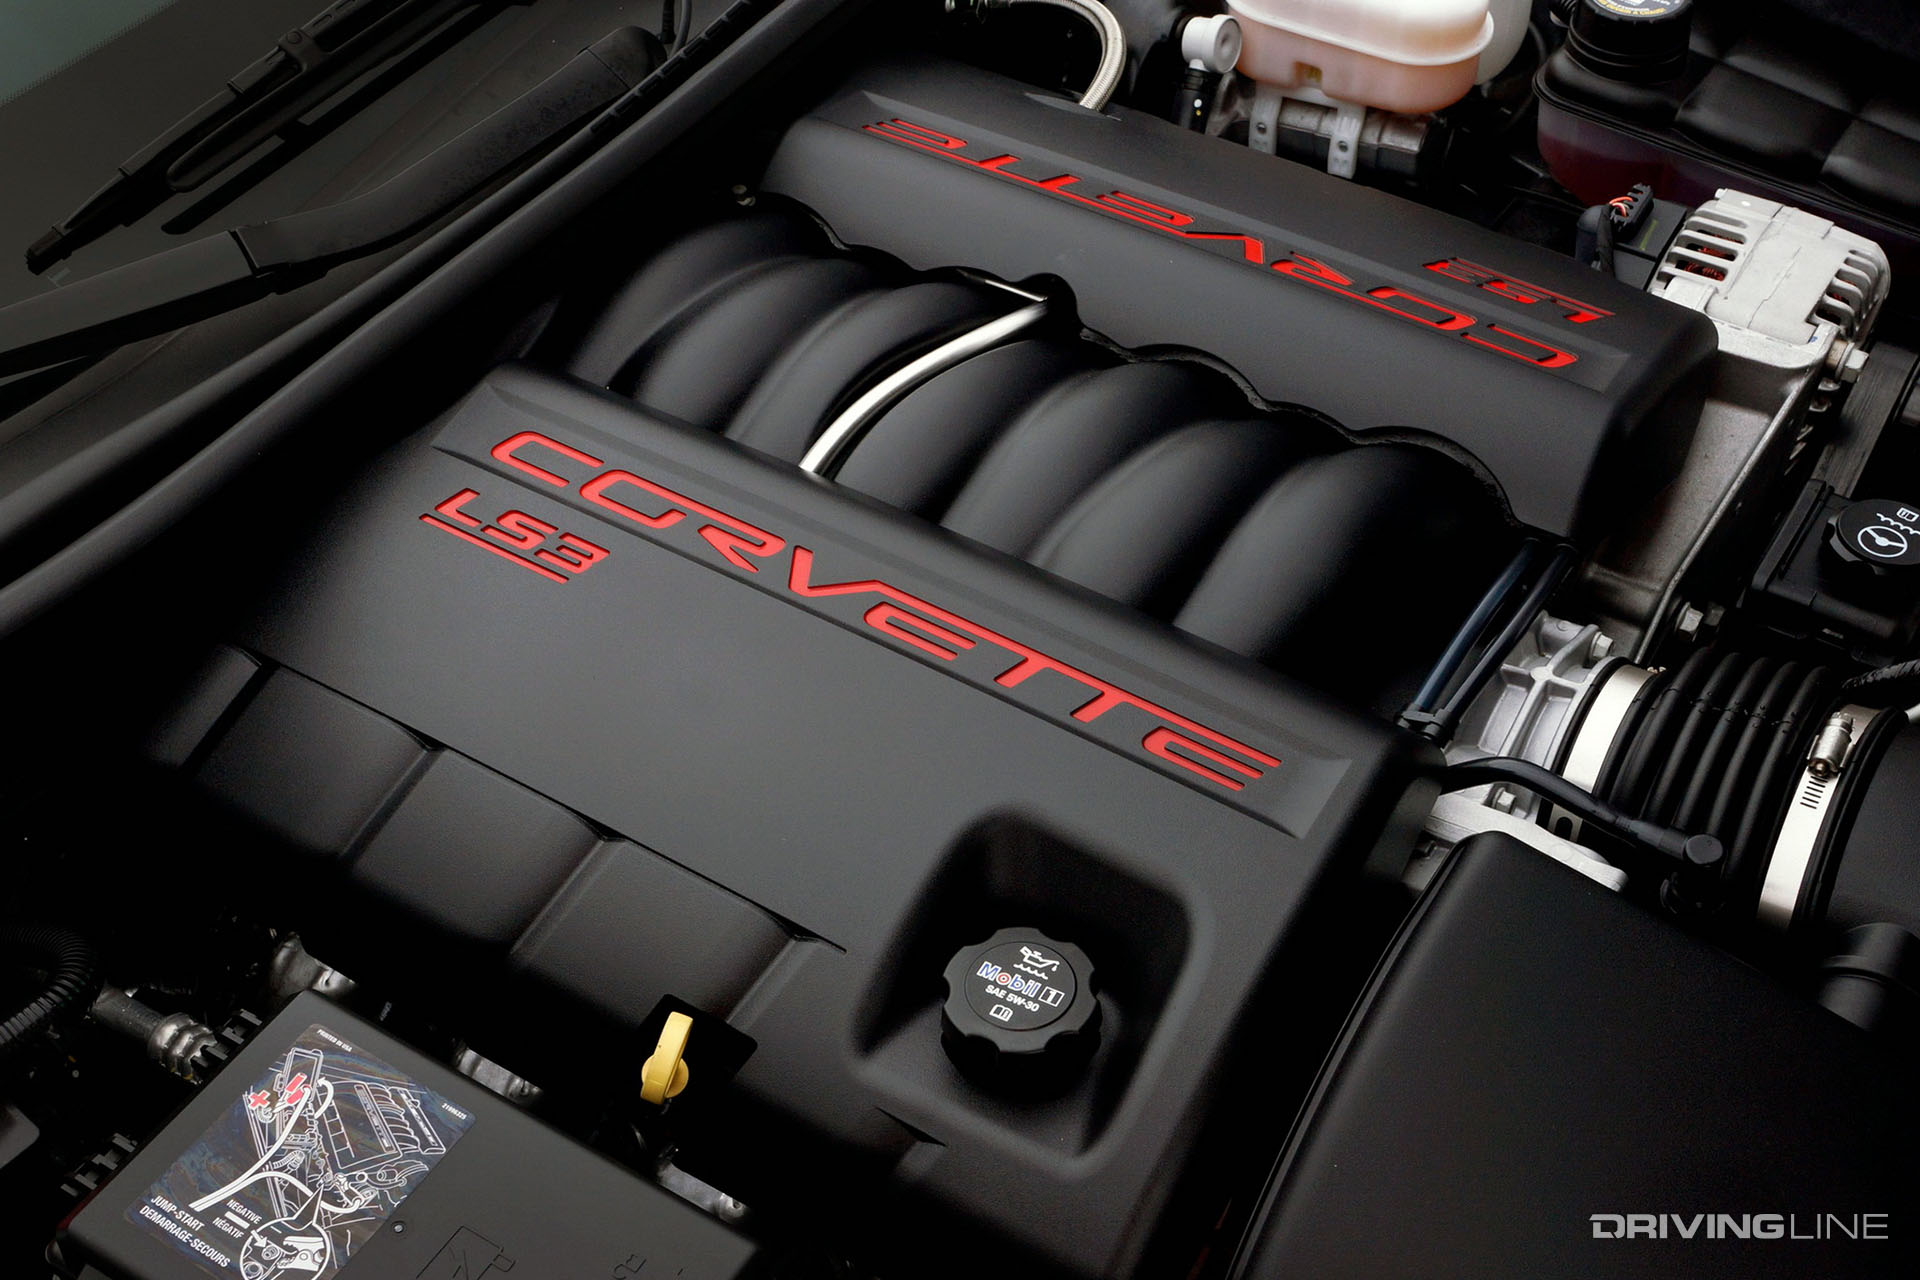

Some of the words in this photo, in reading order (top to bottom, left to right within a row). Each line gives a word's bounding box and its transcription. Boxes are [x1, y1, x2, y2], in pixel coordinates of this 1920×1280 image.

[862, 117, 1580, 368] CORVETTE
[1422, 258, 1606, 325] LS3
[434, 488, 611, 575] LS3
[490, 431, 1282, 792] CORVETTE
[977, 961, 1042, 998] Mobil
[985, 985, 1007, 999] SAE
[1006, 993, 1040, 1012] 5W-30
[342, 1042, 353, 1052] USA
[151, 1195, 205, 1232] JUMP-START
[212, 1217, 245, 1240] NÉGATIF
[226, 1199, 263, 1225] NEGATIVE
[139, 1205, 231, 1268] DEMARRAGE-SECOURS
